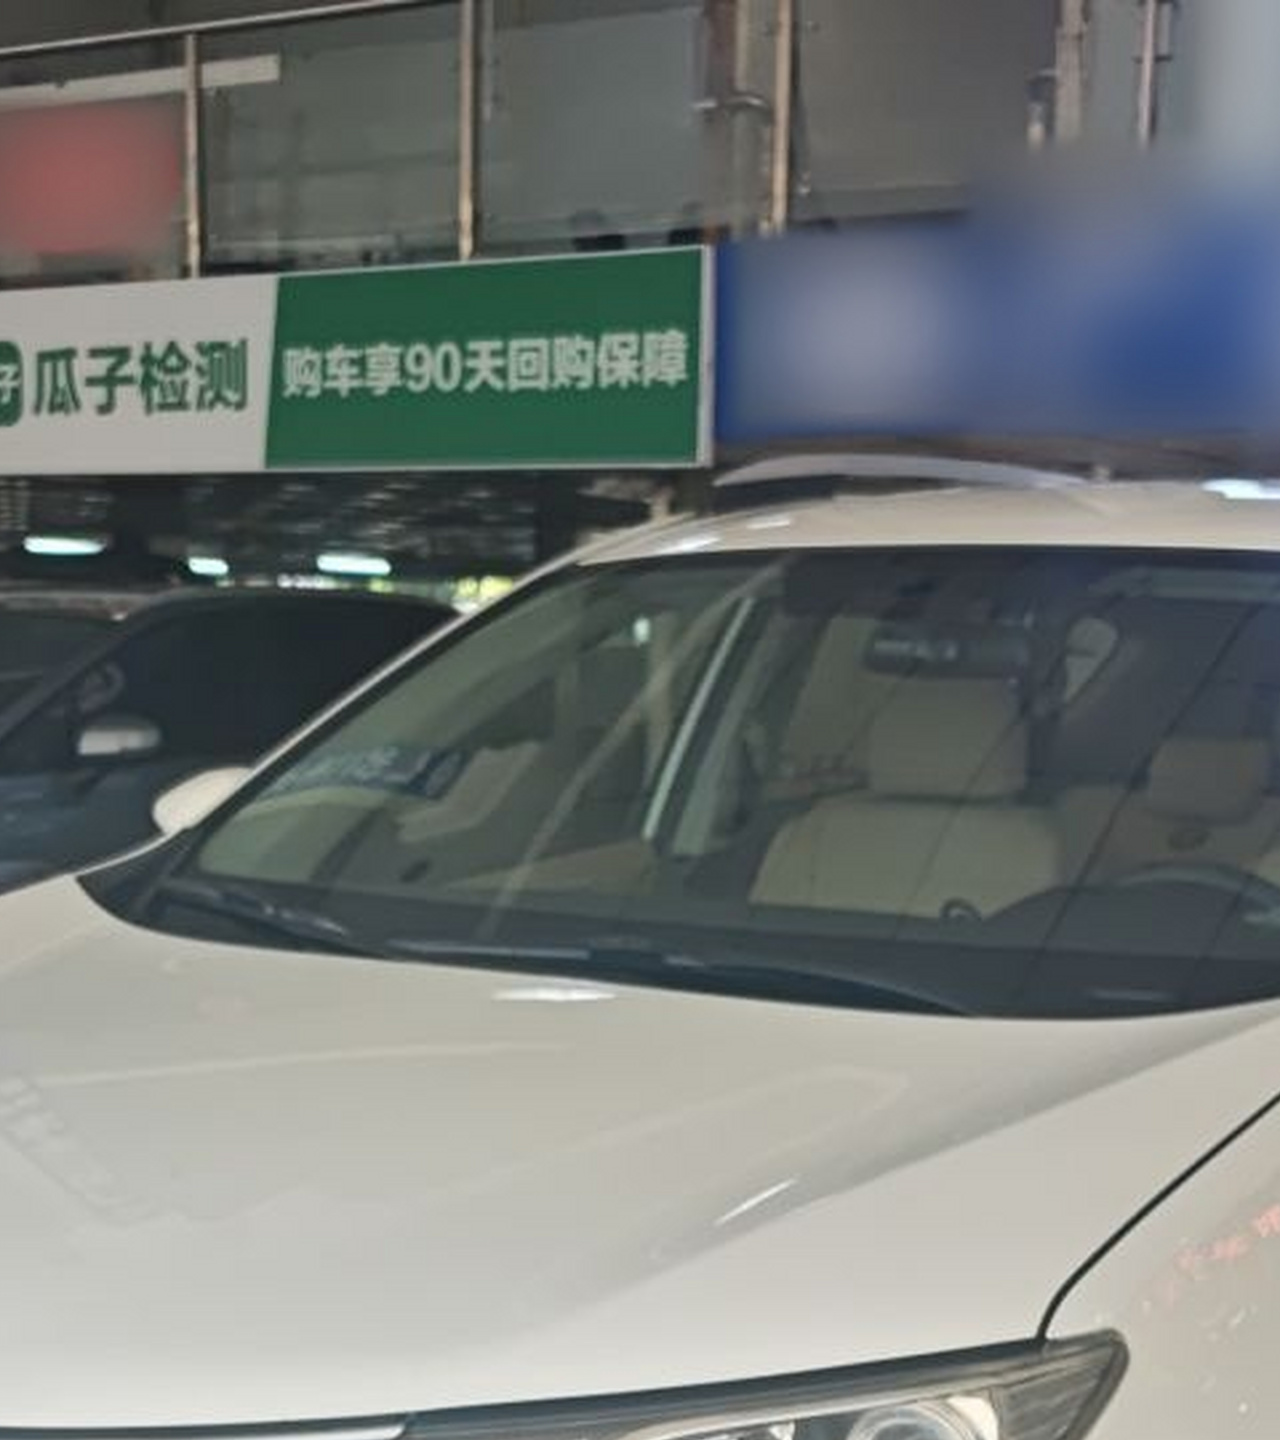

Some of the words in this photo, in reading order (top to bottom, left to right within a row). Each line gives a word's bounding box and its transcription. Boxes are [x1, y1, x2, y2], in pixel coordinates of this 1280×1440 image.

[33, 337, 249, 416] 瓜子检测
[282, 329, 688, 399] 购车享90天回购保障
